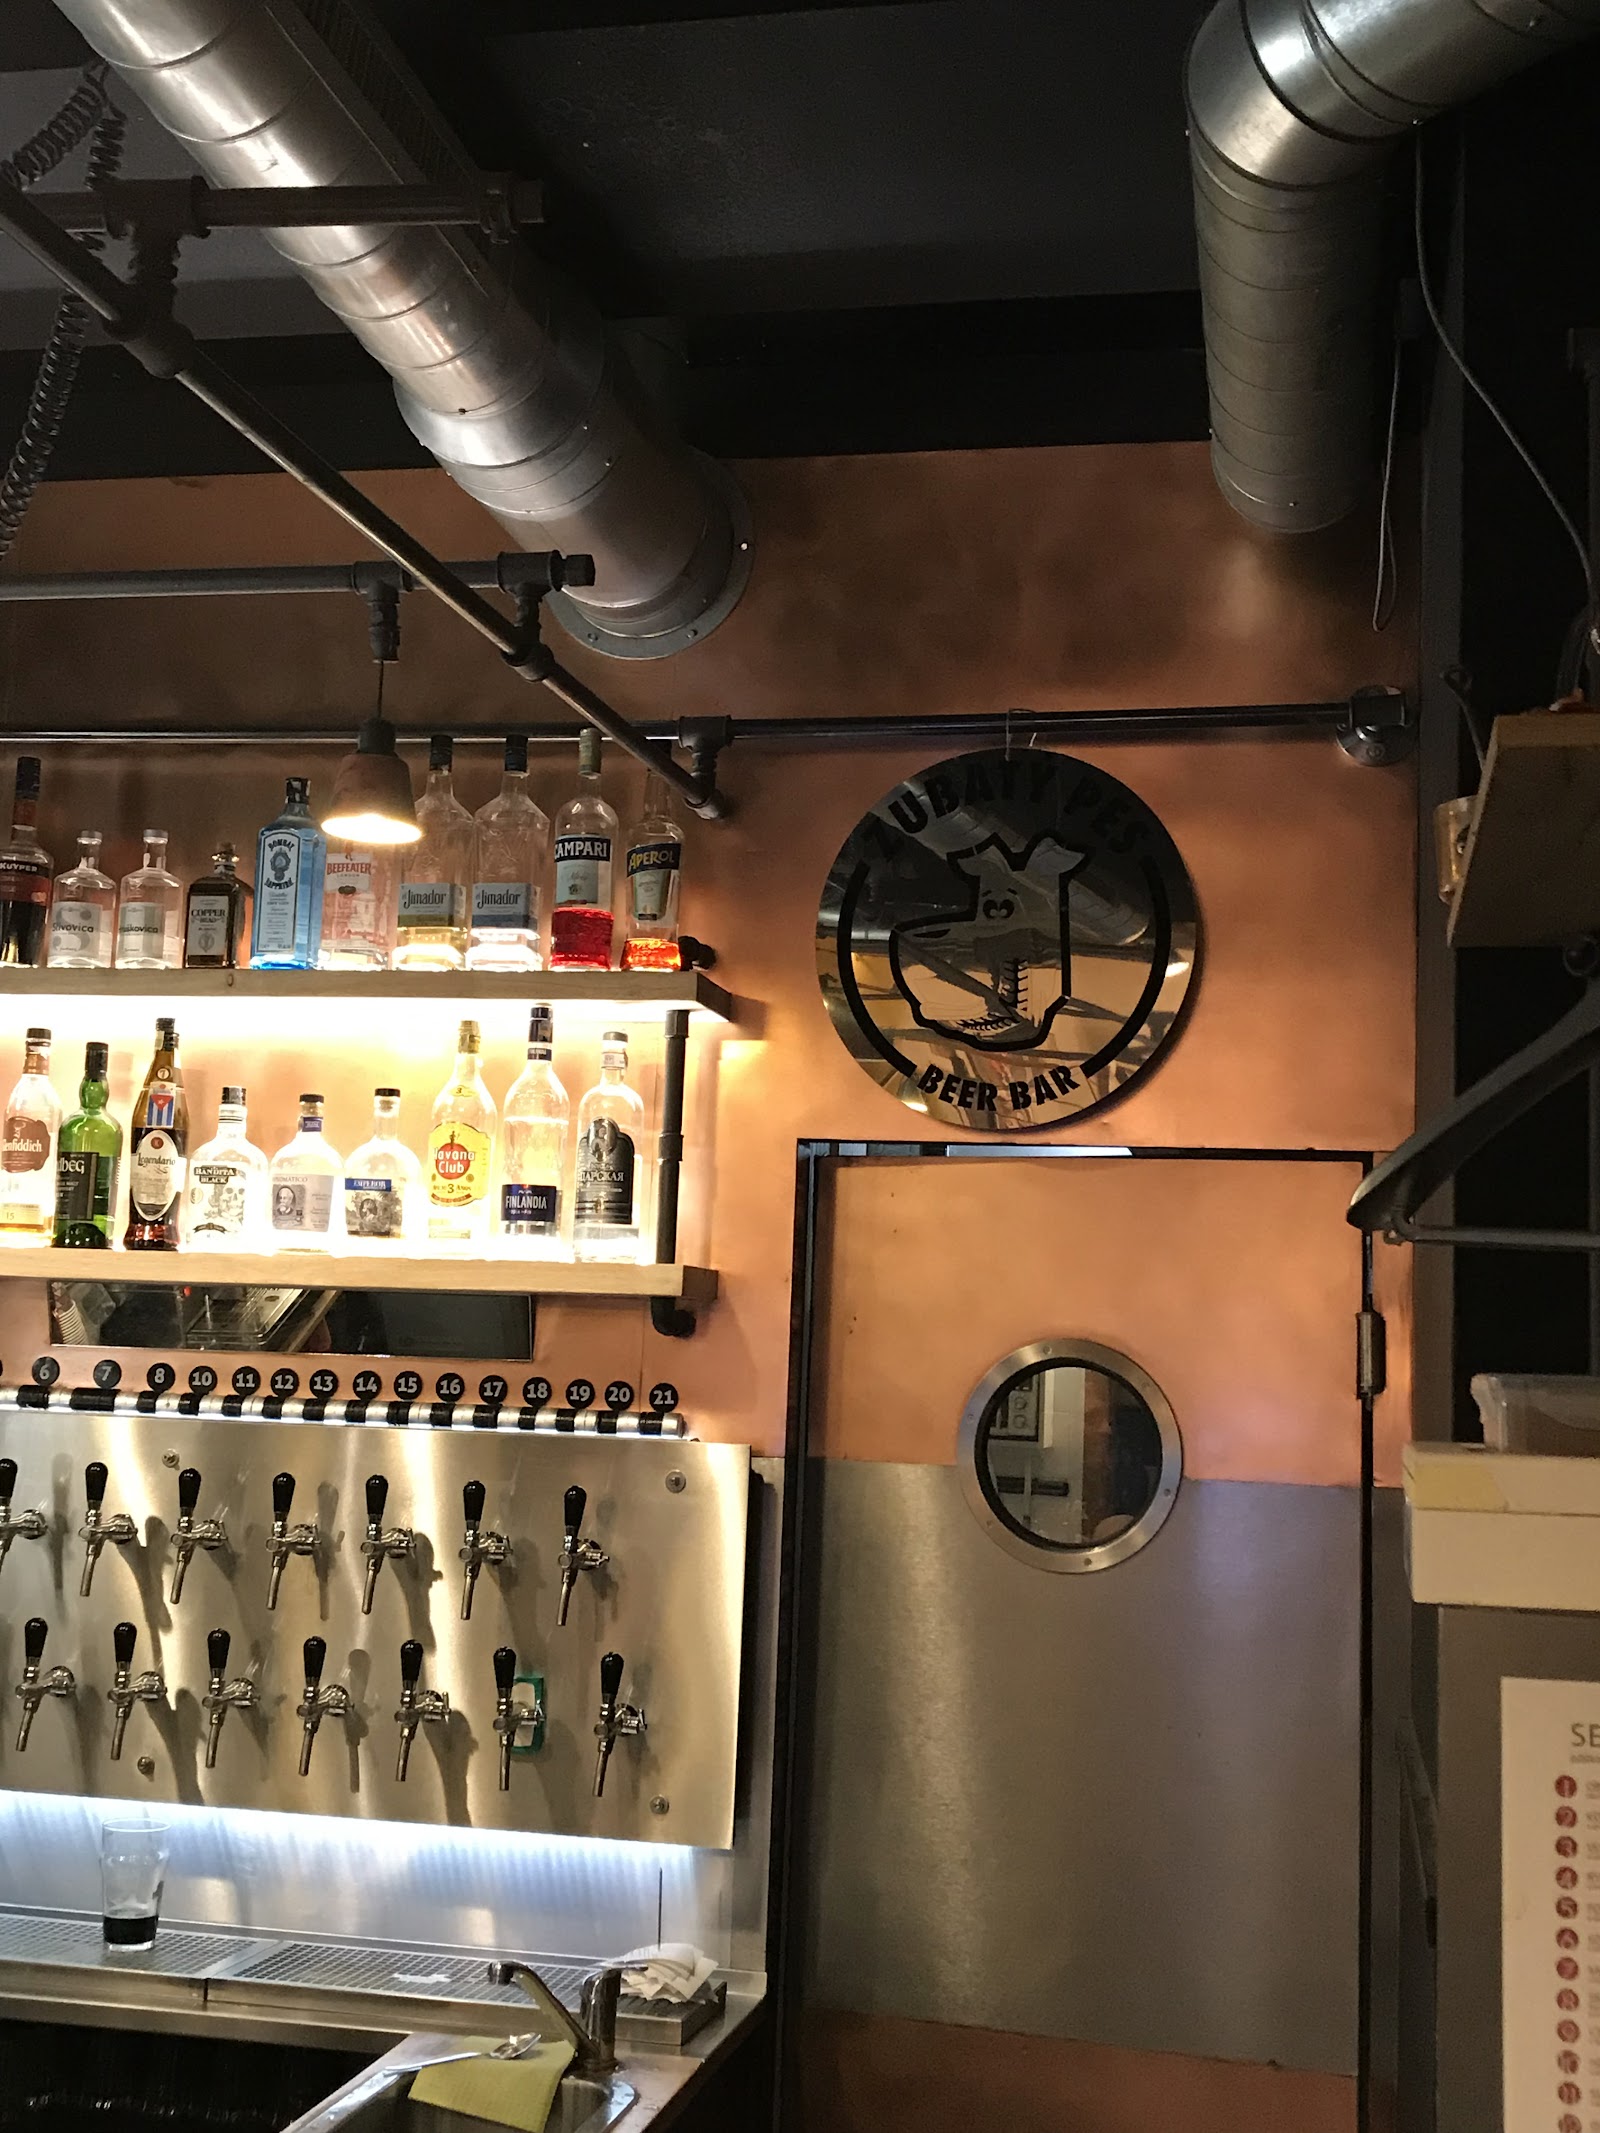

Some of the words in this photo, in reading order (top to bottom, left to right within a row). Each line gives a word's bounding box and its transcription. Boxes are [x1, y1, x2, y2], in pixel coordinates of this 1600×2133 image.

[268, 838, 295, 852] BOMBAY
[326, 862, 372, 876] BEEFEATER
[629, 850, 675, 873] APEROL
[264, 877, 294, 890] SAPPHIRE
[403, 889, 447, 910] Jimador
[477, 889, 521, 910] Jimador
[191, 908, 226, 917] COPPER
[917, 1064, 999, 1112] BEER
[1008, 1064, 1081, 1111] BAR
[438, 1161, 465, 1174] Club
[447, 1183, 455, 1194] 3
[505, 1195, 548, 1210] FINLANDIA
[39, 1364, 51, 1380] 6
[100, 1365, 113, 1381] 7
[154, 1368, 166, 1383] 8
[192, 1371, 213, 1386] 10
[235, 1373, 256, 1388] 11
[274, 1375, 295, 1390] 12
[313, 1376, 334, 1392] 13
[355, 1377, 378, 1393] 14
[397, 1377, 418, 1393] 15
[439, 1379, 461, 1395] 16
[483, 1381, 504, 1397] 17
[526, 1383, 548, 1399] 18
[569, 1385, 590, 1401] 19
[608, 1387, 631, 1403] 20
[653, 1389, 675, 1405] 21
